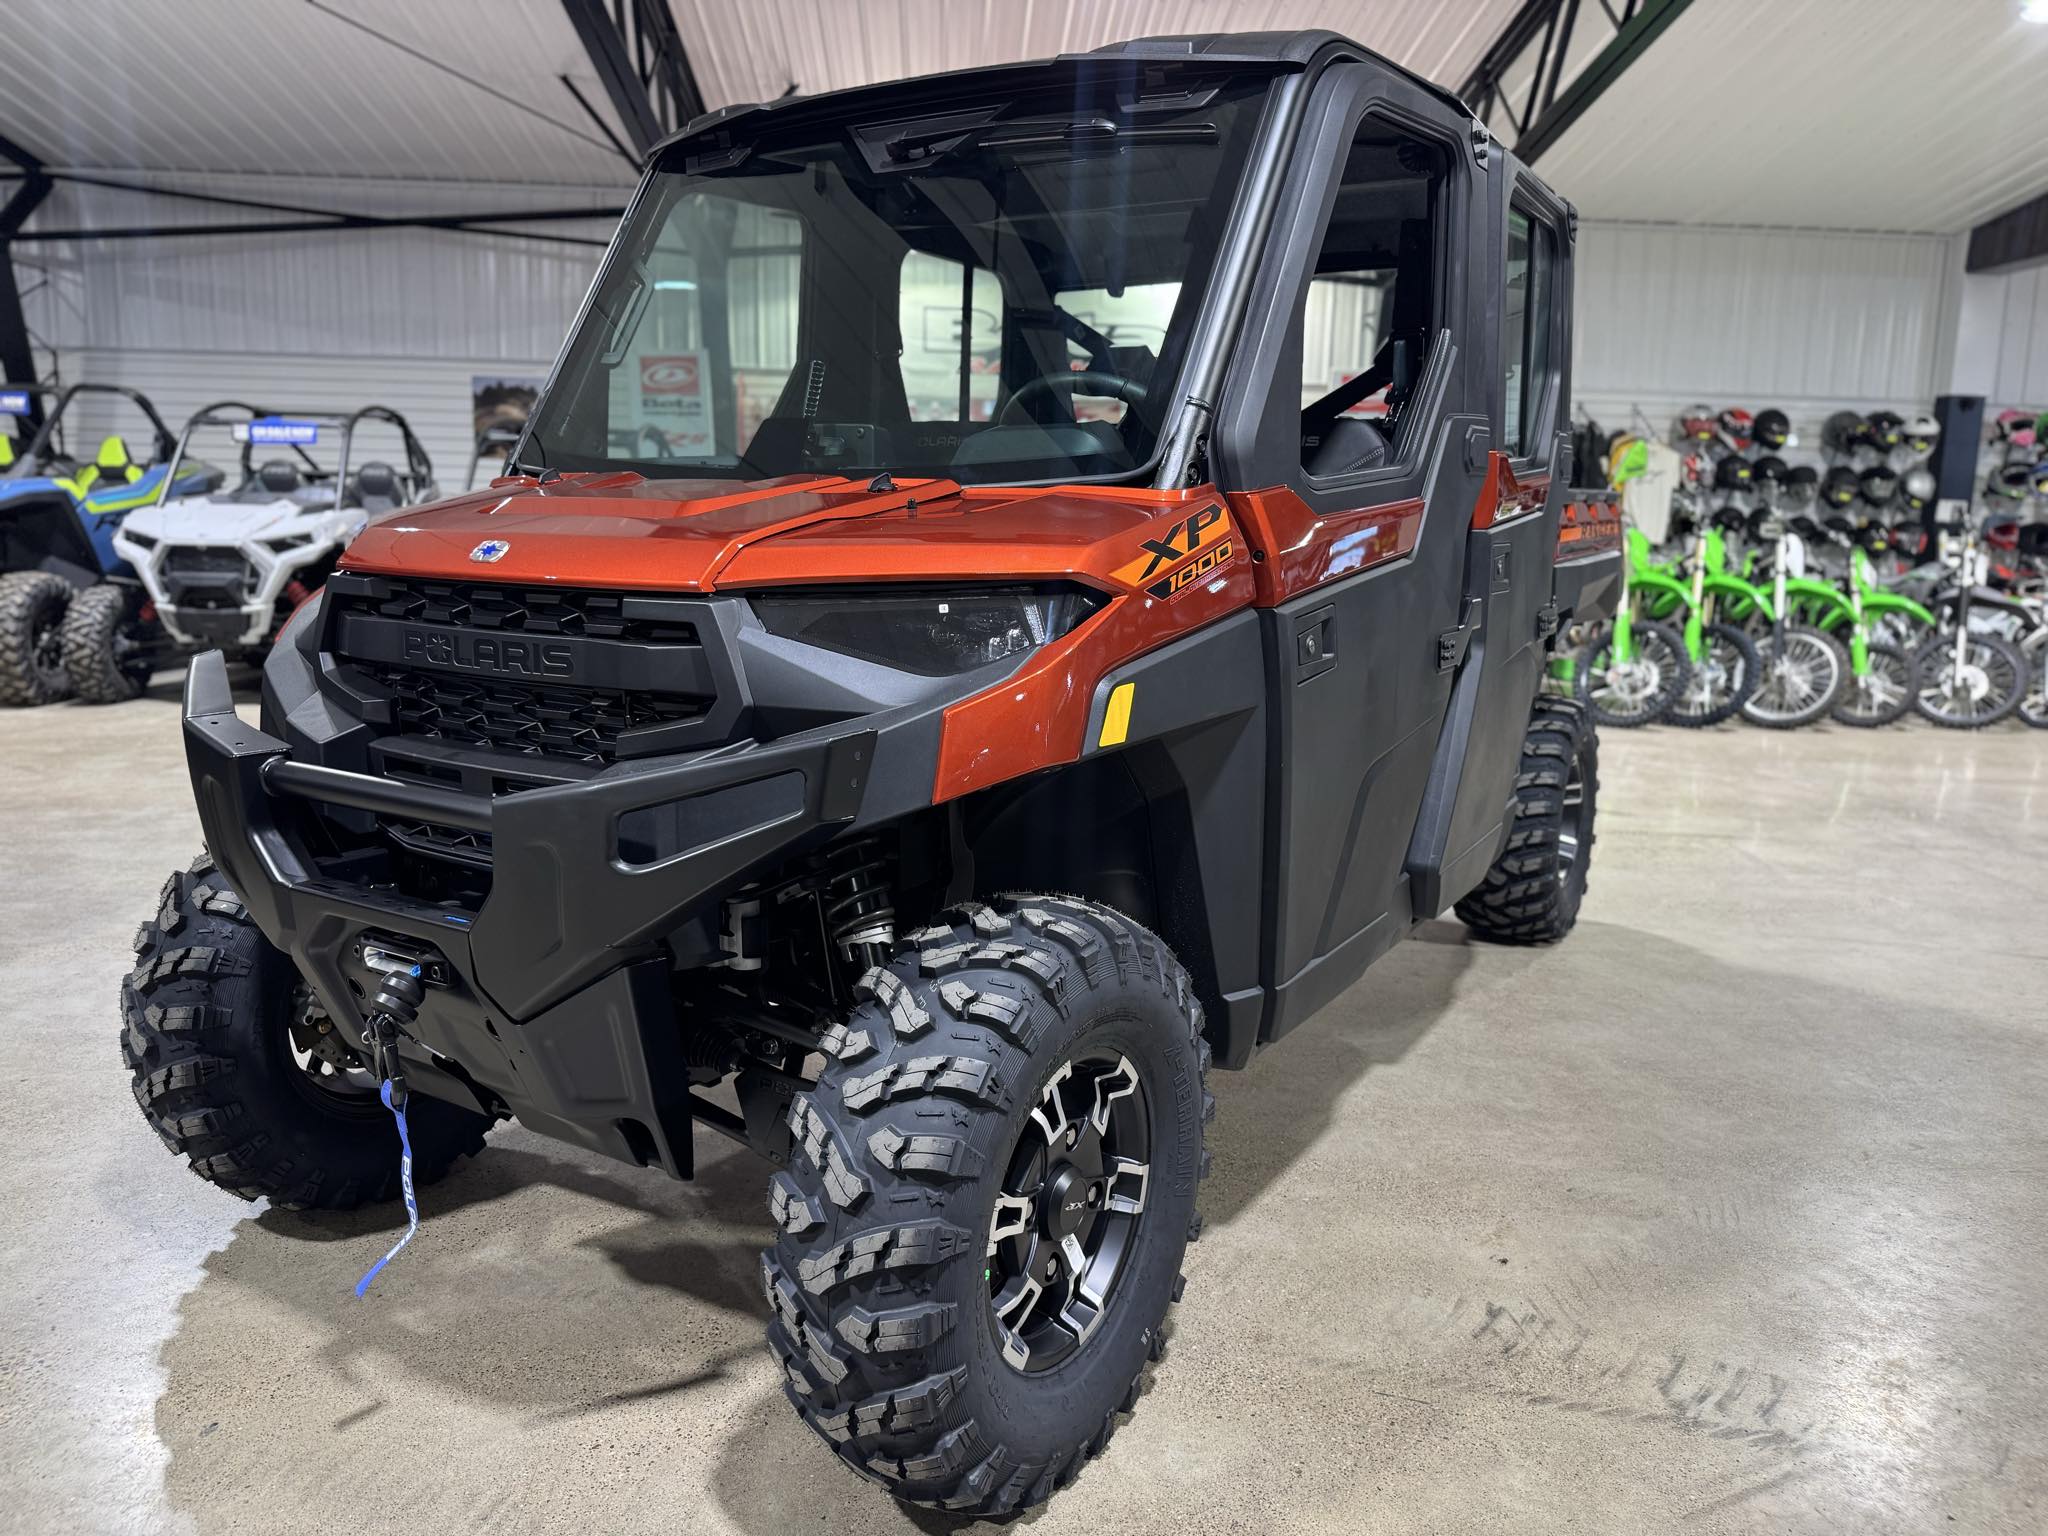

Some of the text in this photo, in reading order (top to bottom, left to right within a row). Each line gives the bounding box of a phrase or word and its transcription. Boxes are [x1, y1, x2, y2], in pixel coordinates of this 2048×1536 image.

[1137, 503, 1222, 583] XP
[1169, 540, 1233, 593] 1000
[403, 630, 575, 678] POLARIS
